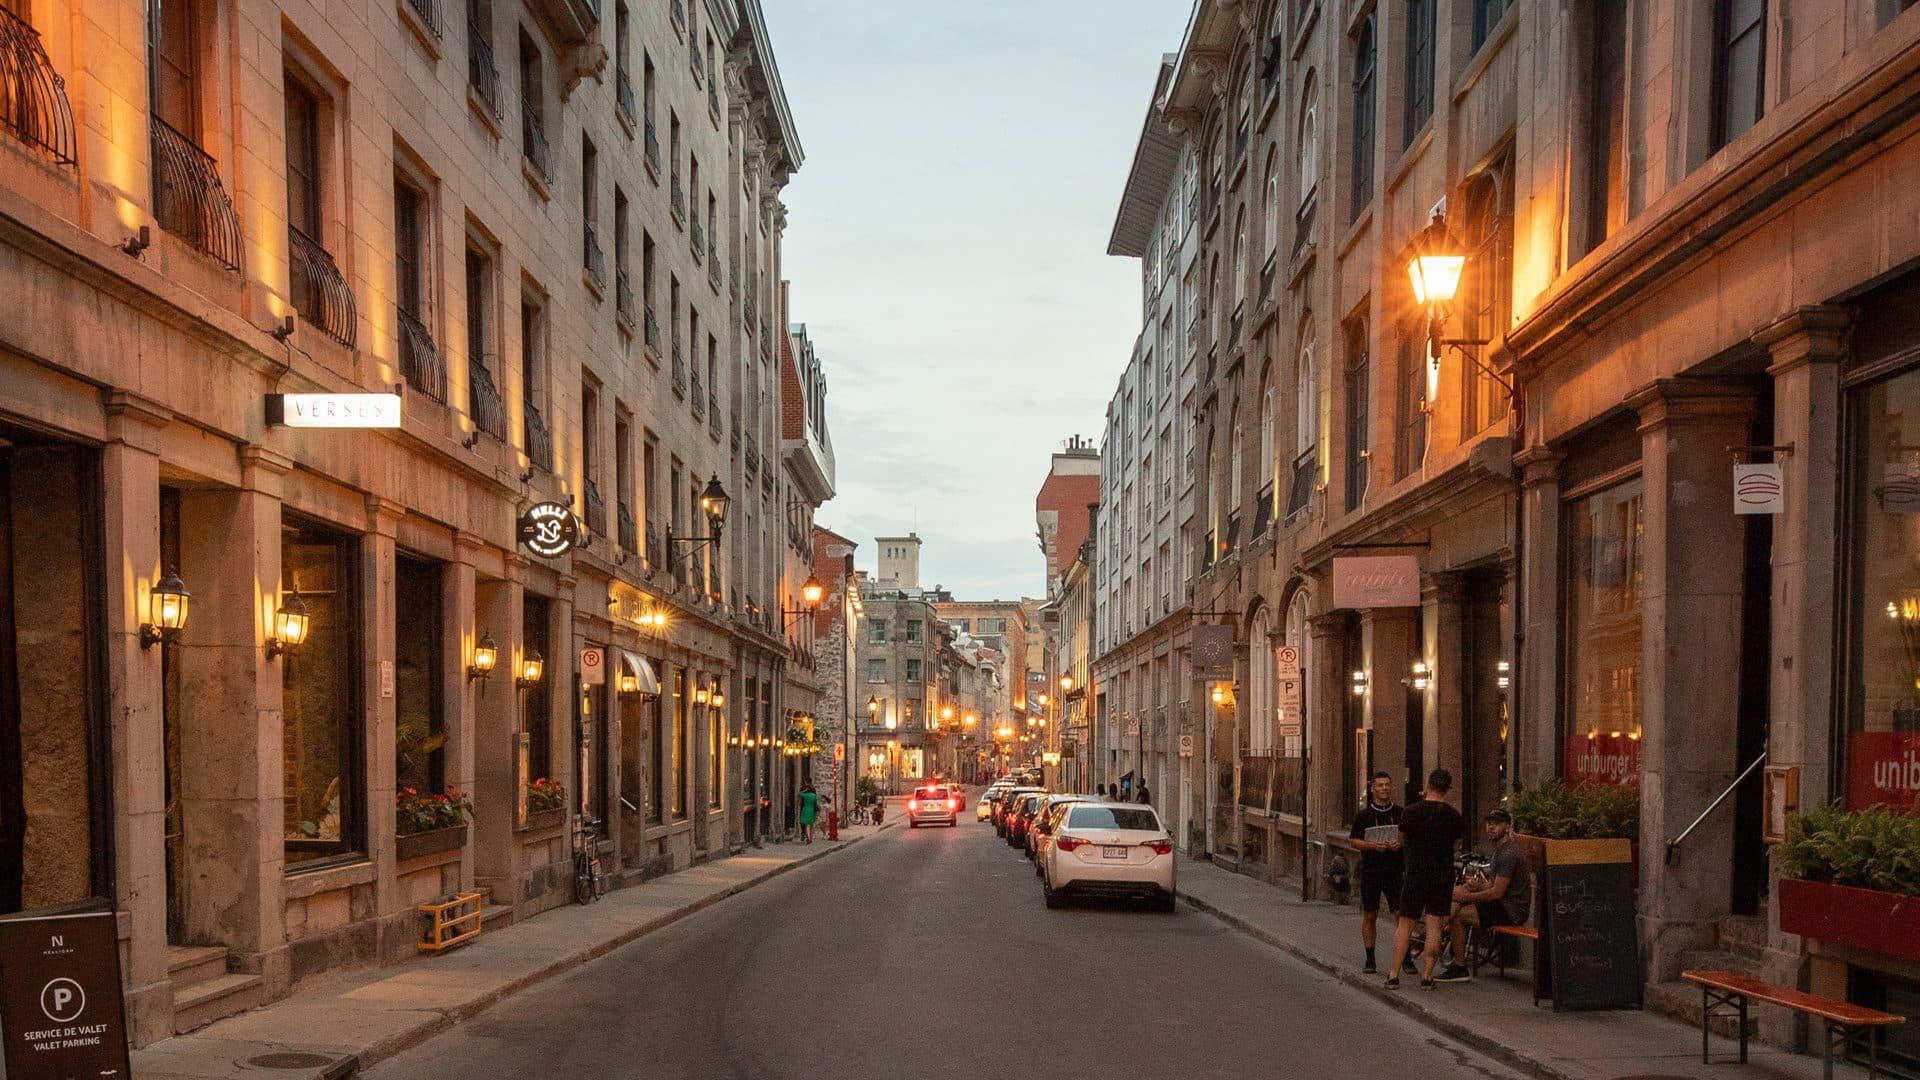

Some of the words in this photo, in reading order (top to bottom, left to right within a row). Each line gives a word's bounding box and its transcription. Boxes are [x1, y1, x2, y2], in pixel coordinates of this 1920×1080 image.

[295, 400, 383, 418] VERSES
[530, 504, 568, 520] NELLI
[1285, 682, 1294, 694] P
[1577, 745, 1630, 780] uniburger
[51, 935, 64, 947] N
[54, 988, 73, 1011] P
[24, 1028, 62, 1041] SERVICE
[64, 1027, 77, 1036] DE
[78, 1024, 108, 1036] VALET
[33, 1041, 60, 1052] VALET
[62, 1036, 100, 1049] PARKING
